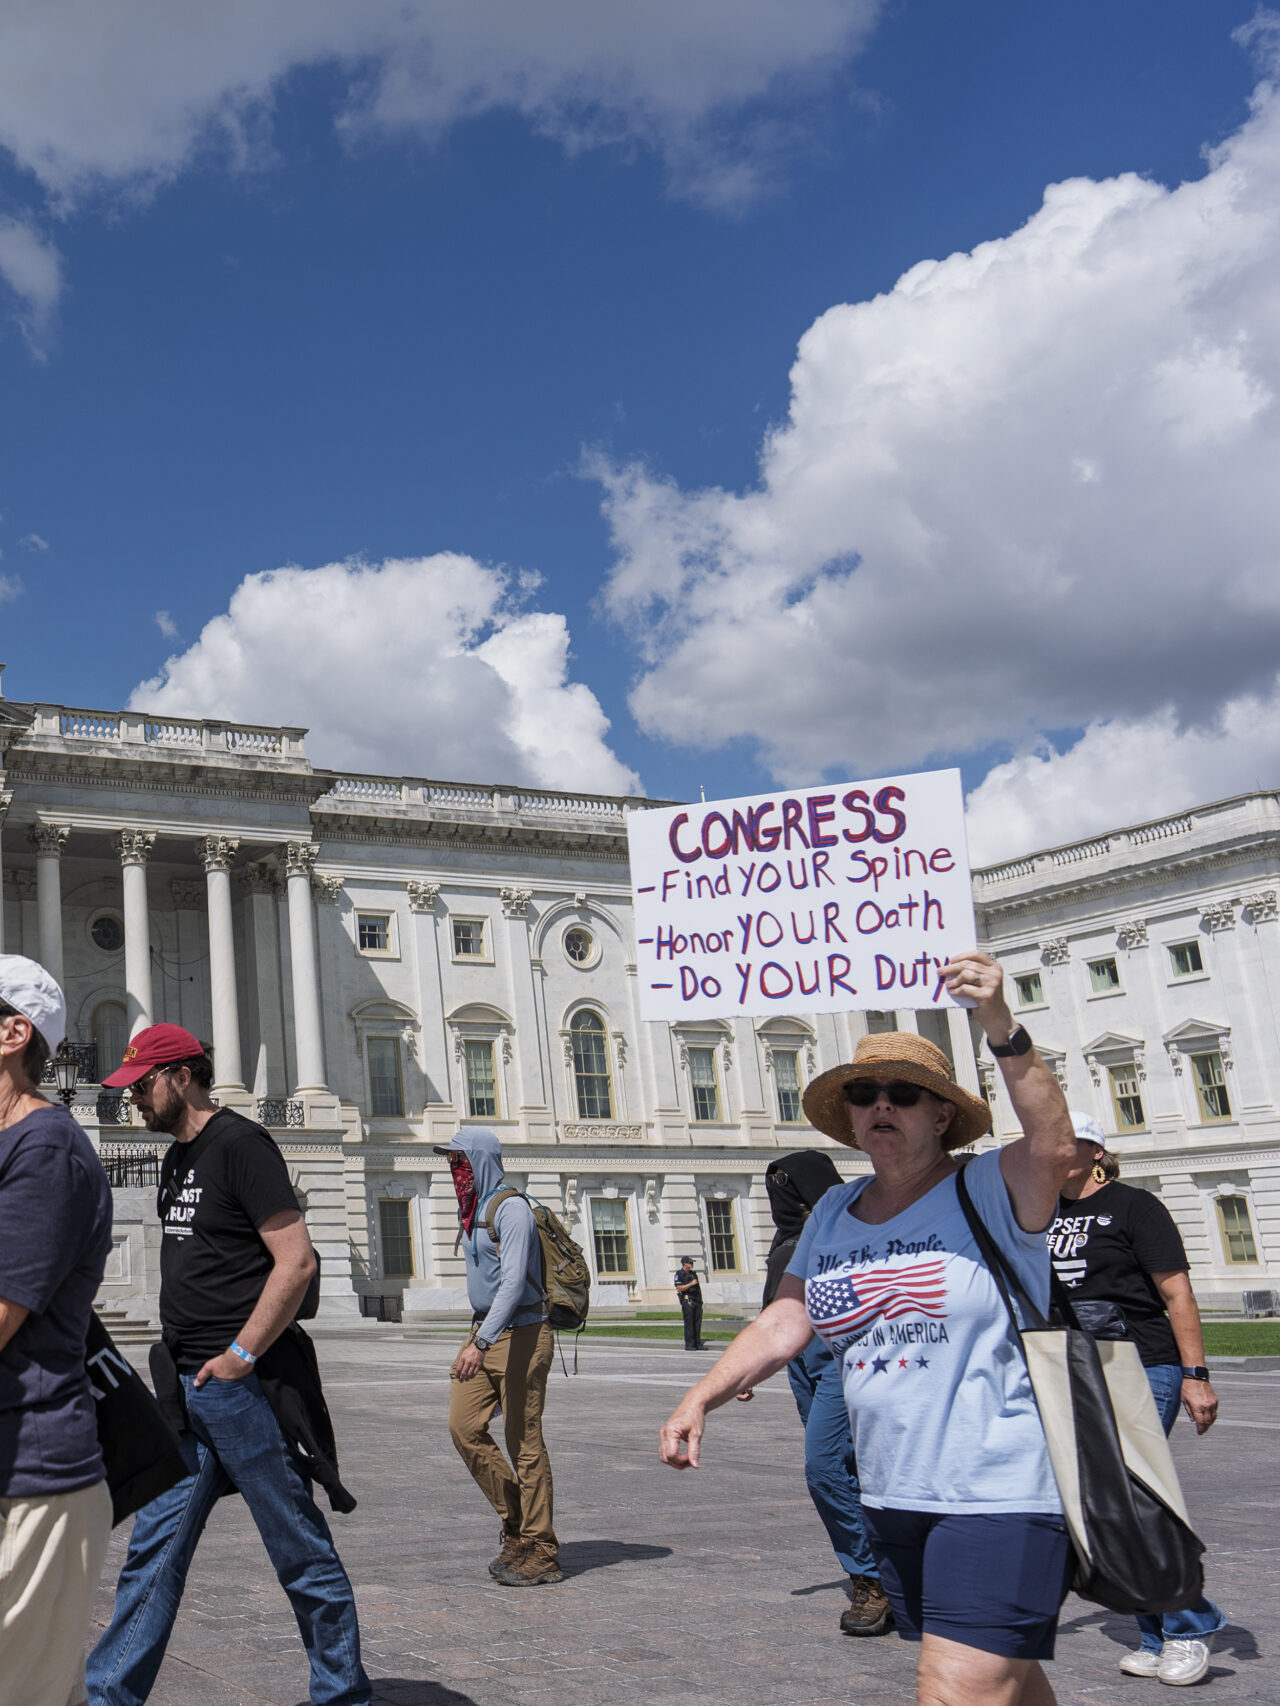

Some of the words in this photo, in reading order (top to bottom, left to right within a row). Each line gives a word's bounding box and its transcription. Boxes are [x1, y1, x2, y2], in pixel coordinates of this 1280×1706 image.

[669, 786, 906, 863] CONGRESS
[738, 851, 835, 896] YOUR
[846, 847, 956, 892] Spine
[737, 902, 848, 955] YOUR
[856, 890, 945, 934] Oath
[735, 953, 857, 1004] YOUR
[875, 951, 950, 1002] Duty
[1049, 1216, 1095, 1234] PSET
[817, 1253, 843, 1275] We
[842, 1244, 878, 1273] The
[1054, 1233, 1088, 1258] UP
[872, 1326, 886, 1346] IN
[889, 1322, 949, 1345] AMERICA
